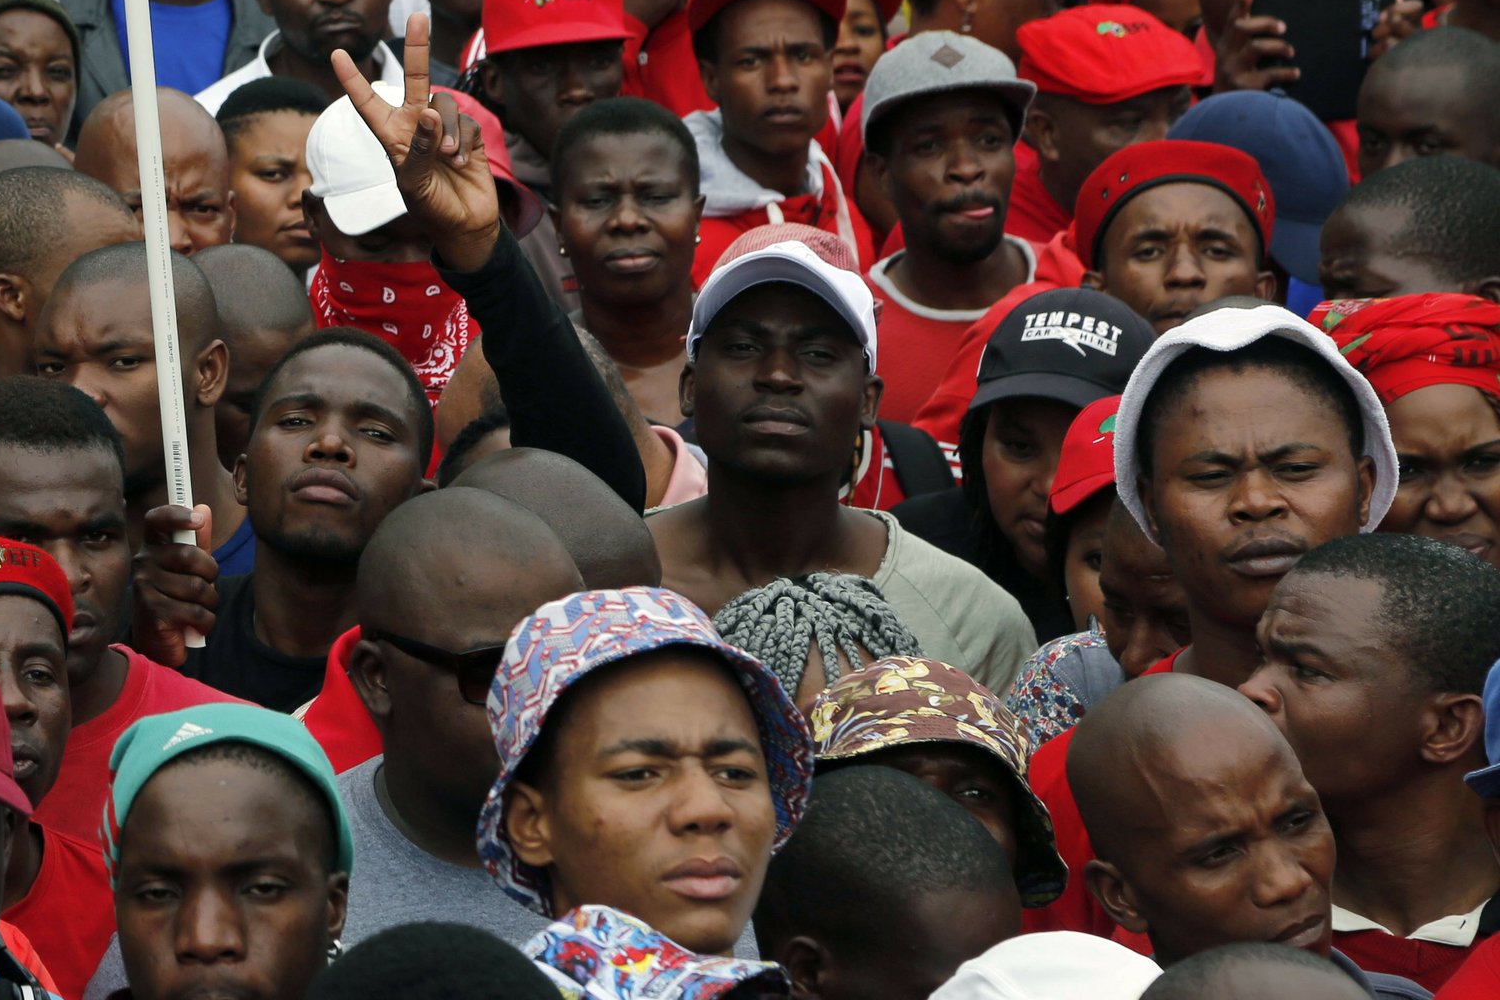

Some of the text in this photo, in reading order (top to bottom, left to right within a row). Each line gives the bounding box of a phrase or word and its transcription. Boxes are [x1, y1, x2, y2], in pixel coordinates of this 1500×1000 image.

[1025, 311, 1122, 341] TEMPEST
[1026, 329, 1113, 350] CAR HIRE
[9, 548, 41, 568] EFF
